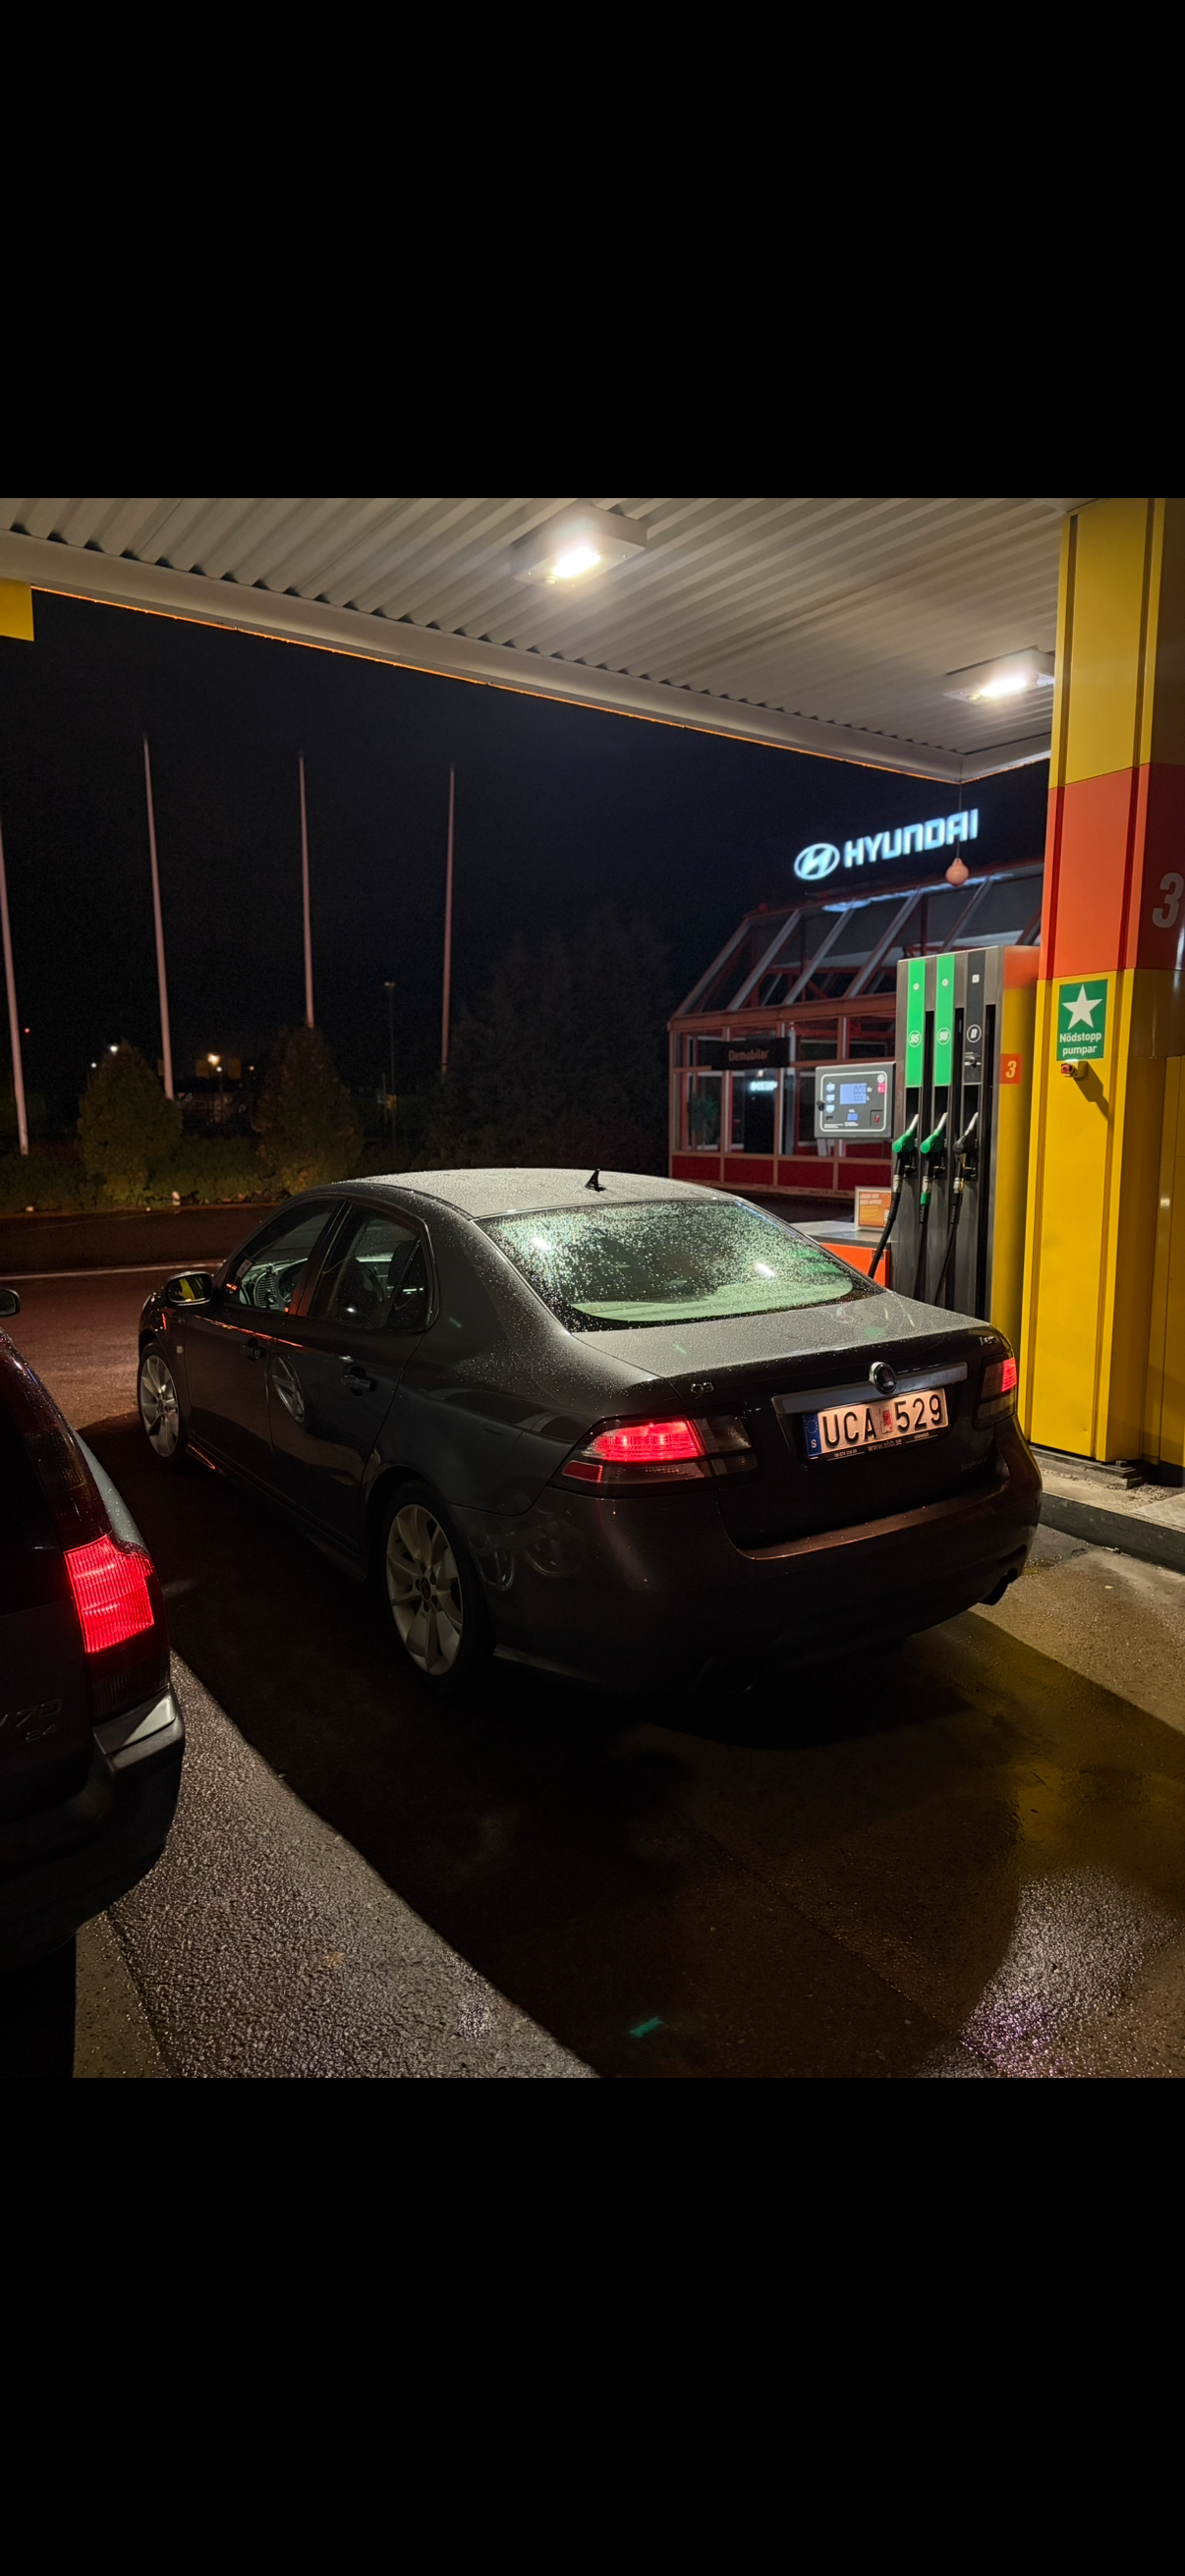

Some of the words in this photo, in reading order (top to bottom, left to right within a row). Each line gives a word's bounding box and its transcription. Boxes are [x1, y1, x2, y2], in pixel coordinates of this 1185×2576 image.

[843, 809, 979, 868] HYUNDAI
[1152, 872, 1185, 928] 3
[910, 1034, 920, 1043] 95
[970, 1028, 978, 1039] D
[1059, 1032, 1101, 1043] Nödstopp
[1062, 1045, 1098, 1057] pumpar
[1005, 1060, 1017, 1079] 3
[820, 1411, 878, 1447] UCA
[894, 1393, 942, 1431] 529
[811, 1438, 818, 1448] S
